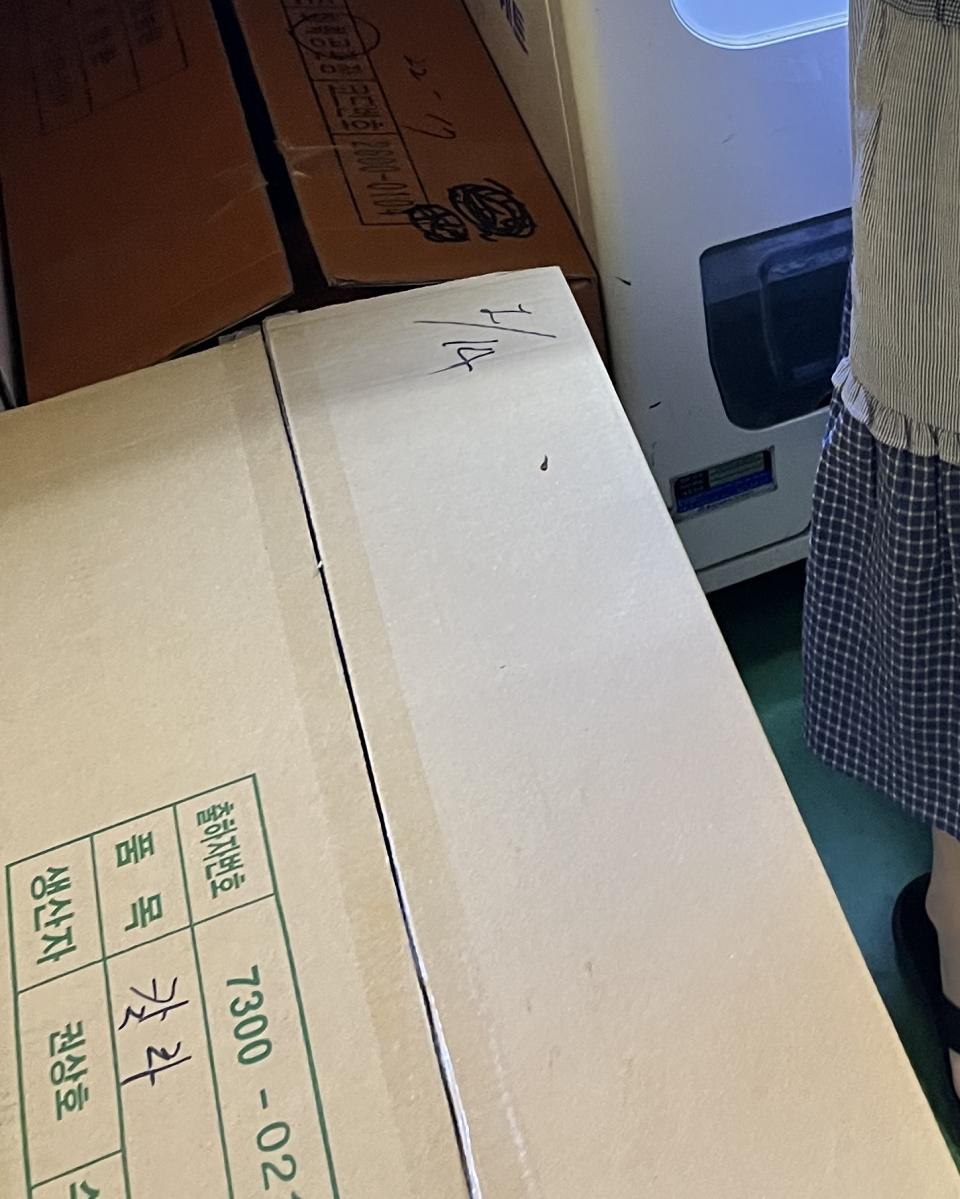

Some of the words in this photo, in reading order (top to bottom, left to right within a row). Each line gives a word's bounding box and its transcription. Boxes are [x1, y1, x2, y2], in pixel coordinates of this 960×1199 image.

[29, 864, 78, 965] 생산자
[196, 801, 246, 899] 출하자번호
[226, 964, 273, 1065] 7300
[256, 1121, 304, 1199] 02
[48, 1020, 90, 1121] 권상호
